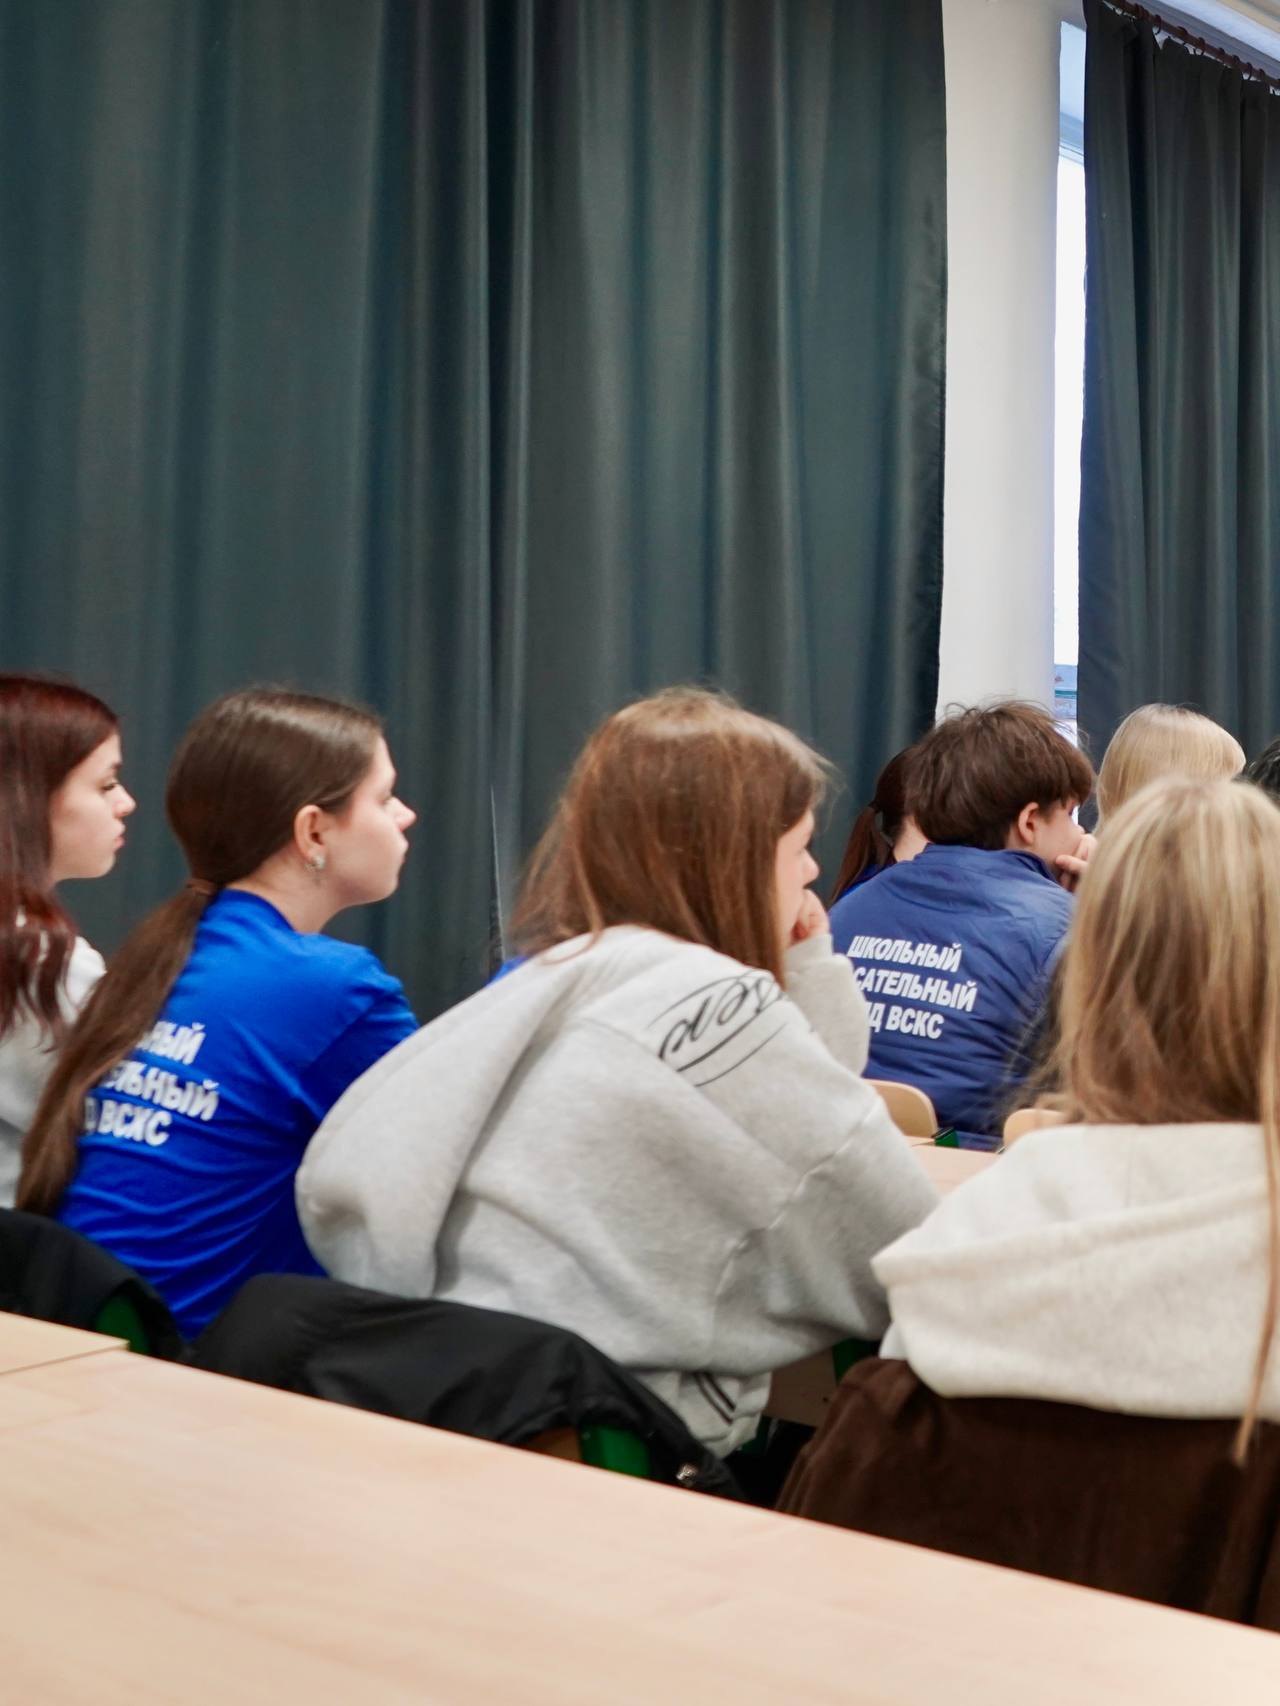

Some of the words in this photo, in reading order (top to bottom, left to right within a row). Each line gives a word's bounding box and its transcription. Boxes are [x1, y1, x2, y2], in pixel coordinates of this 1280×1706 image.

[847, 935, 962, 973] ШКОЛЬНЫЙ
[885, 1005, 945, 1039] ВСКС
[98, 1099, 172, 1146] ВСКС
